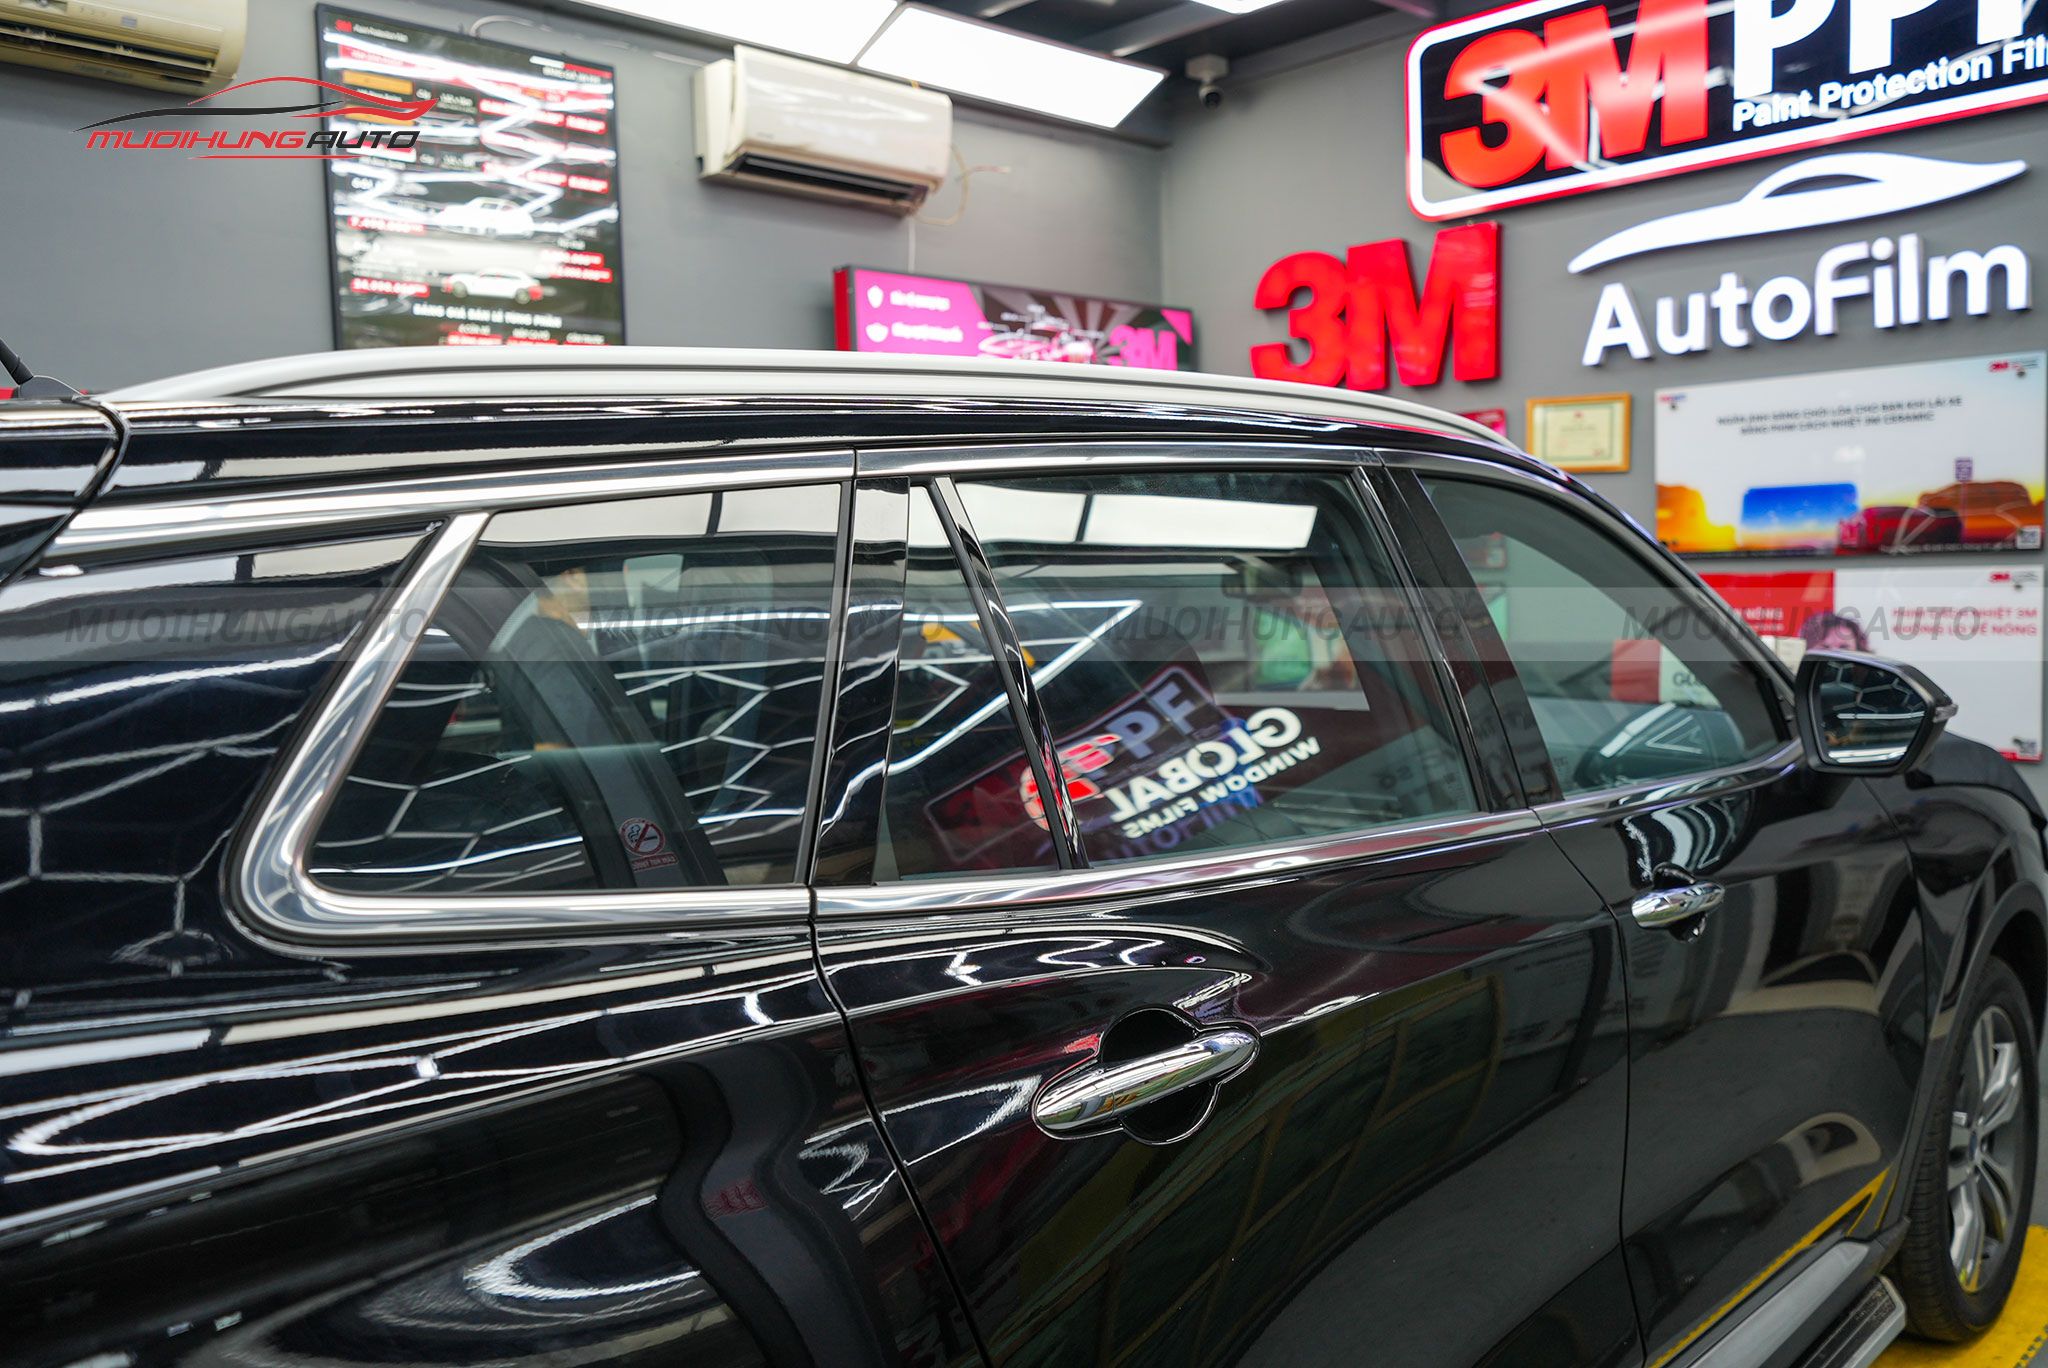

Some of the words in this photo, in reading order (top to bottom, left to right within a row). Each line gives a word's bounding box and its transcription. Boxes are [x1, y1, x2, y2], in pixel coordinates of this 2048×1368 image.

[1440, 0, 1709, 188] 3M
[1732, 89, 1813, 132] Paint
[1819, 52, 1993, 113] Protection
[2002, 33, 2048, 75] Fil
[1108, 326, 1178, 370] 3M
[1250, 222, 1502, 390] 3M
[1581, 233, 2033, 367] AutoFilm
